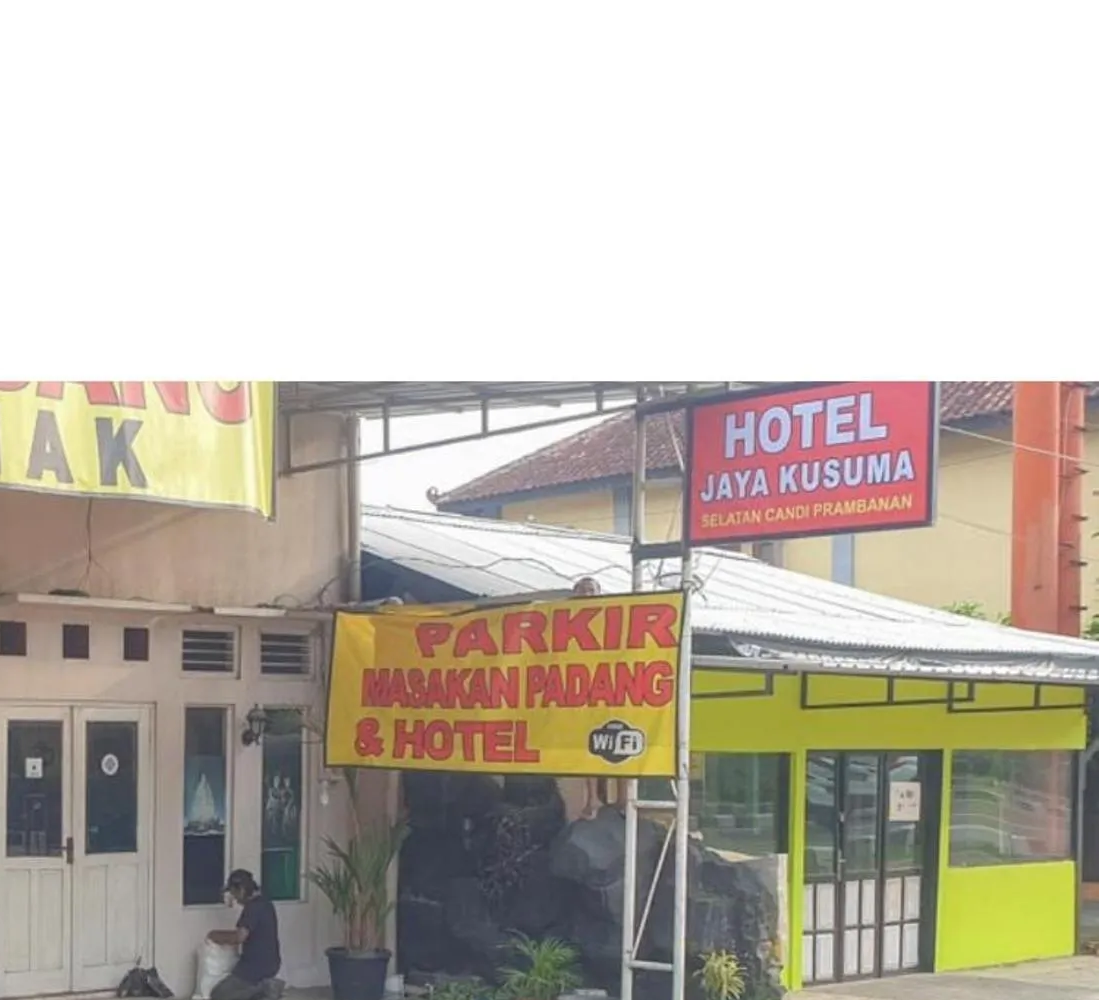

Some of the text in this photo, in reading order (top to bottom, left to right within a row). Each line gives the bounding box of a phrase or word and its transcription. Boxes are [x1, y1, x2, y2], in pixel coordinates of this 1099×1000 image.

[724, 392, 888, 459] HOTEL
[700, 450, 915, 501] JAYA KUSUMA
[701, 494, 912, 528] SELATAN CANDI PRAMBANAN
[415, 603, 677, 657] PARKIR
[361, 660, 674, 709] MASAKAN PADANG
[355, 717, 540, 763] & HOTEL
